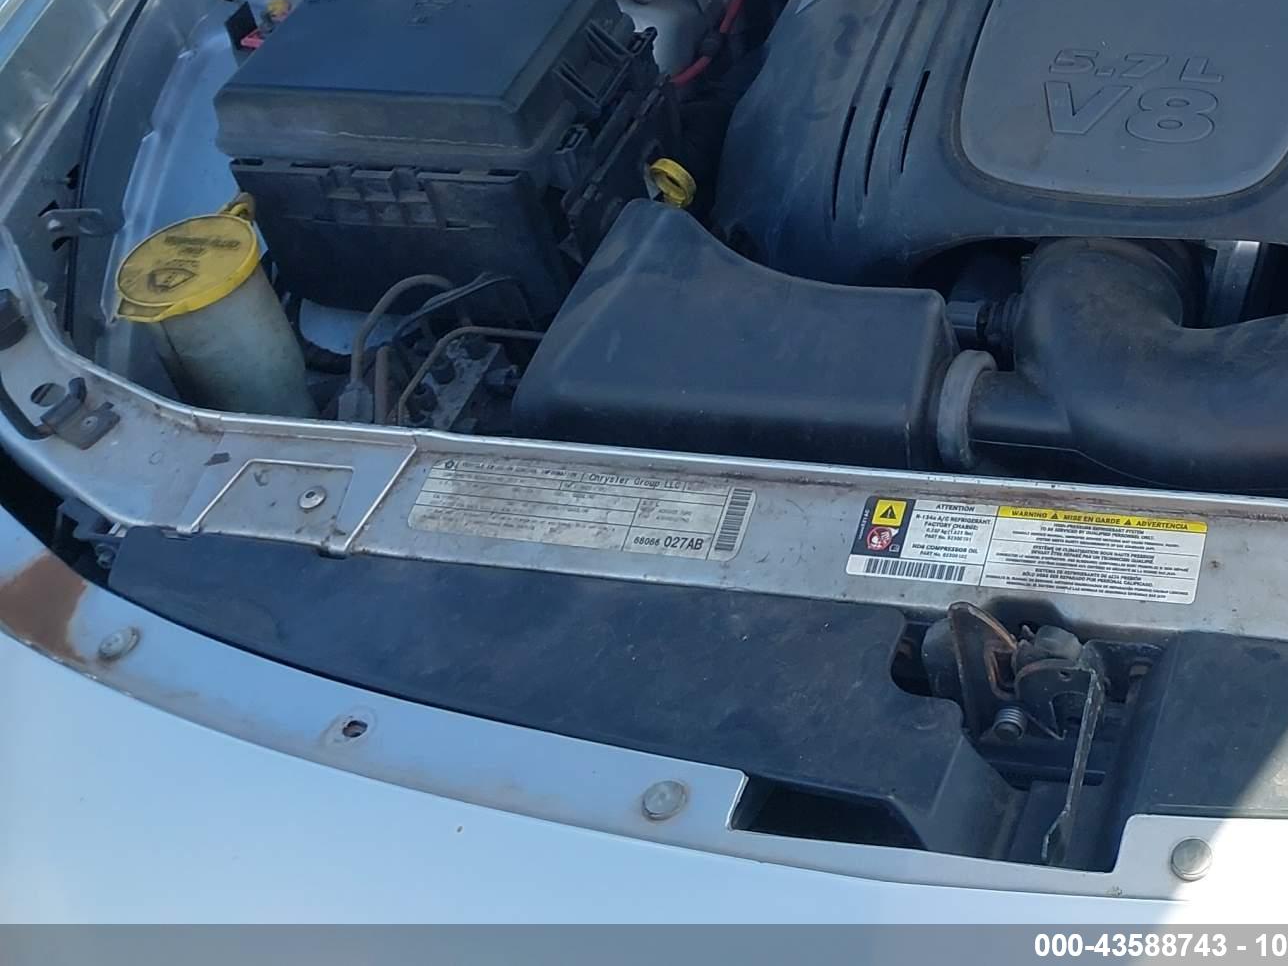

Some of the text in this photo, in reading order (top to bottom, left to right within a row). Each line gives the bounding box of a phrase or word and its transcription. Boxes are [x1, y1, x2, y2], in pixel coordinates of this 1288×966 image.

[1043, 80, 1219, 144] V8
[589, 473, 679, 491] Chrysler Group LLC
[935, 502, 975, 512] ATTENTION
[1012, 509, 1188, 531] WARNING MISE EN GARDE ADVERTENCIA
[663, 535, 705, 551] 027AB
[925, 544, 967, 553] COMPRESSOR
